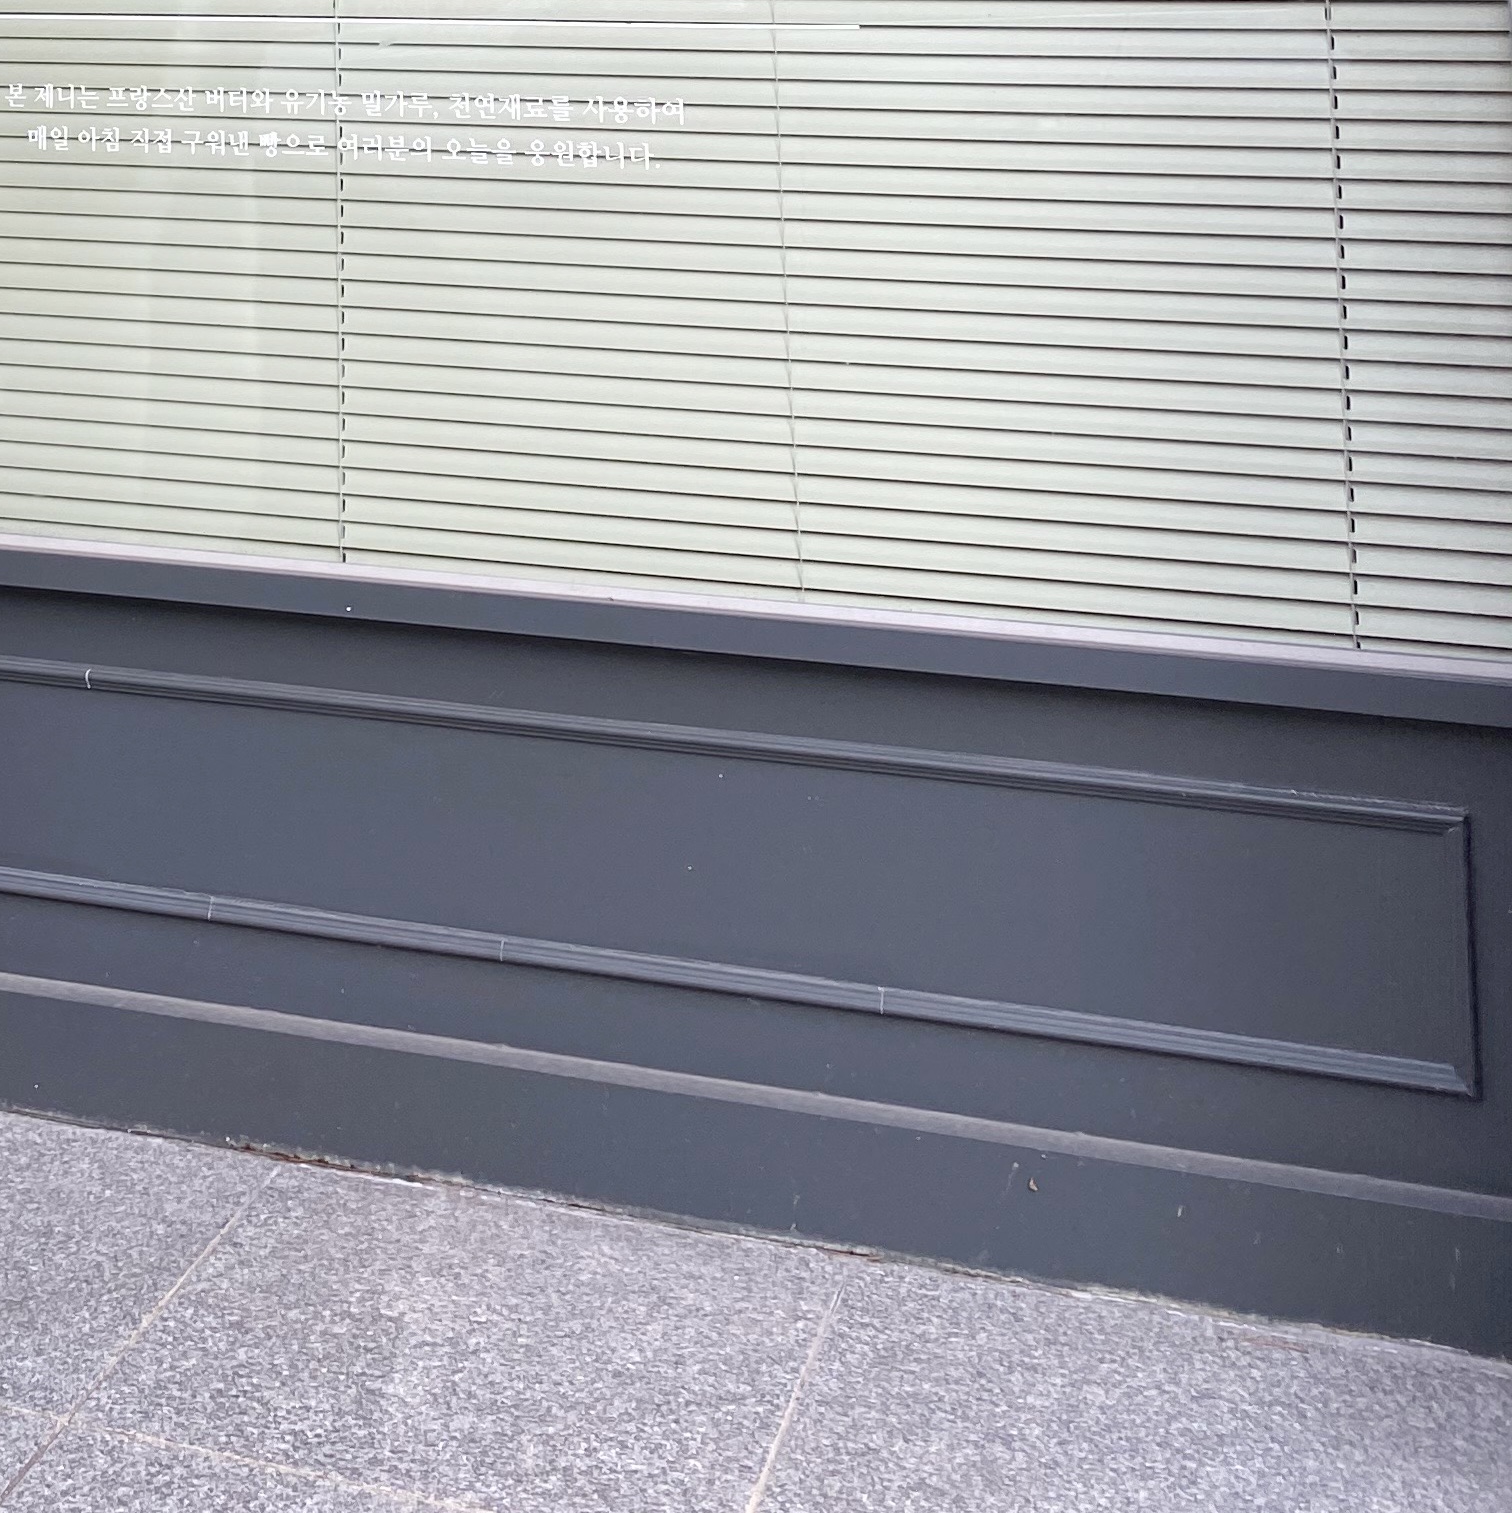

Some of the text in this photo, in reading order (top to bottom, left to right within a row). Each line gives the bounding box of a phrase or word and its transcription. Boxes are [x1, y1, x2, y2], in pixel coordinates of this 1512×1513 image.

[4, 83, 685, 126] 본 제니는 프랑스산 버터와 유기농 밀가루, 천연재료를 사용하여
[27, 125, 69, 151] 매일
[78, 126, 120, 152] 아침
[130, 127, 172, 154] 직접
[181, 130, 250, 156] 구워낸
[259, 131, 329, 158] 빵으로
[338, 133, 432, 163] 여러분의
[442, 137, 517, 165] 오늘을
